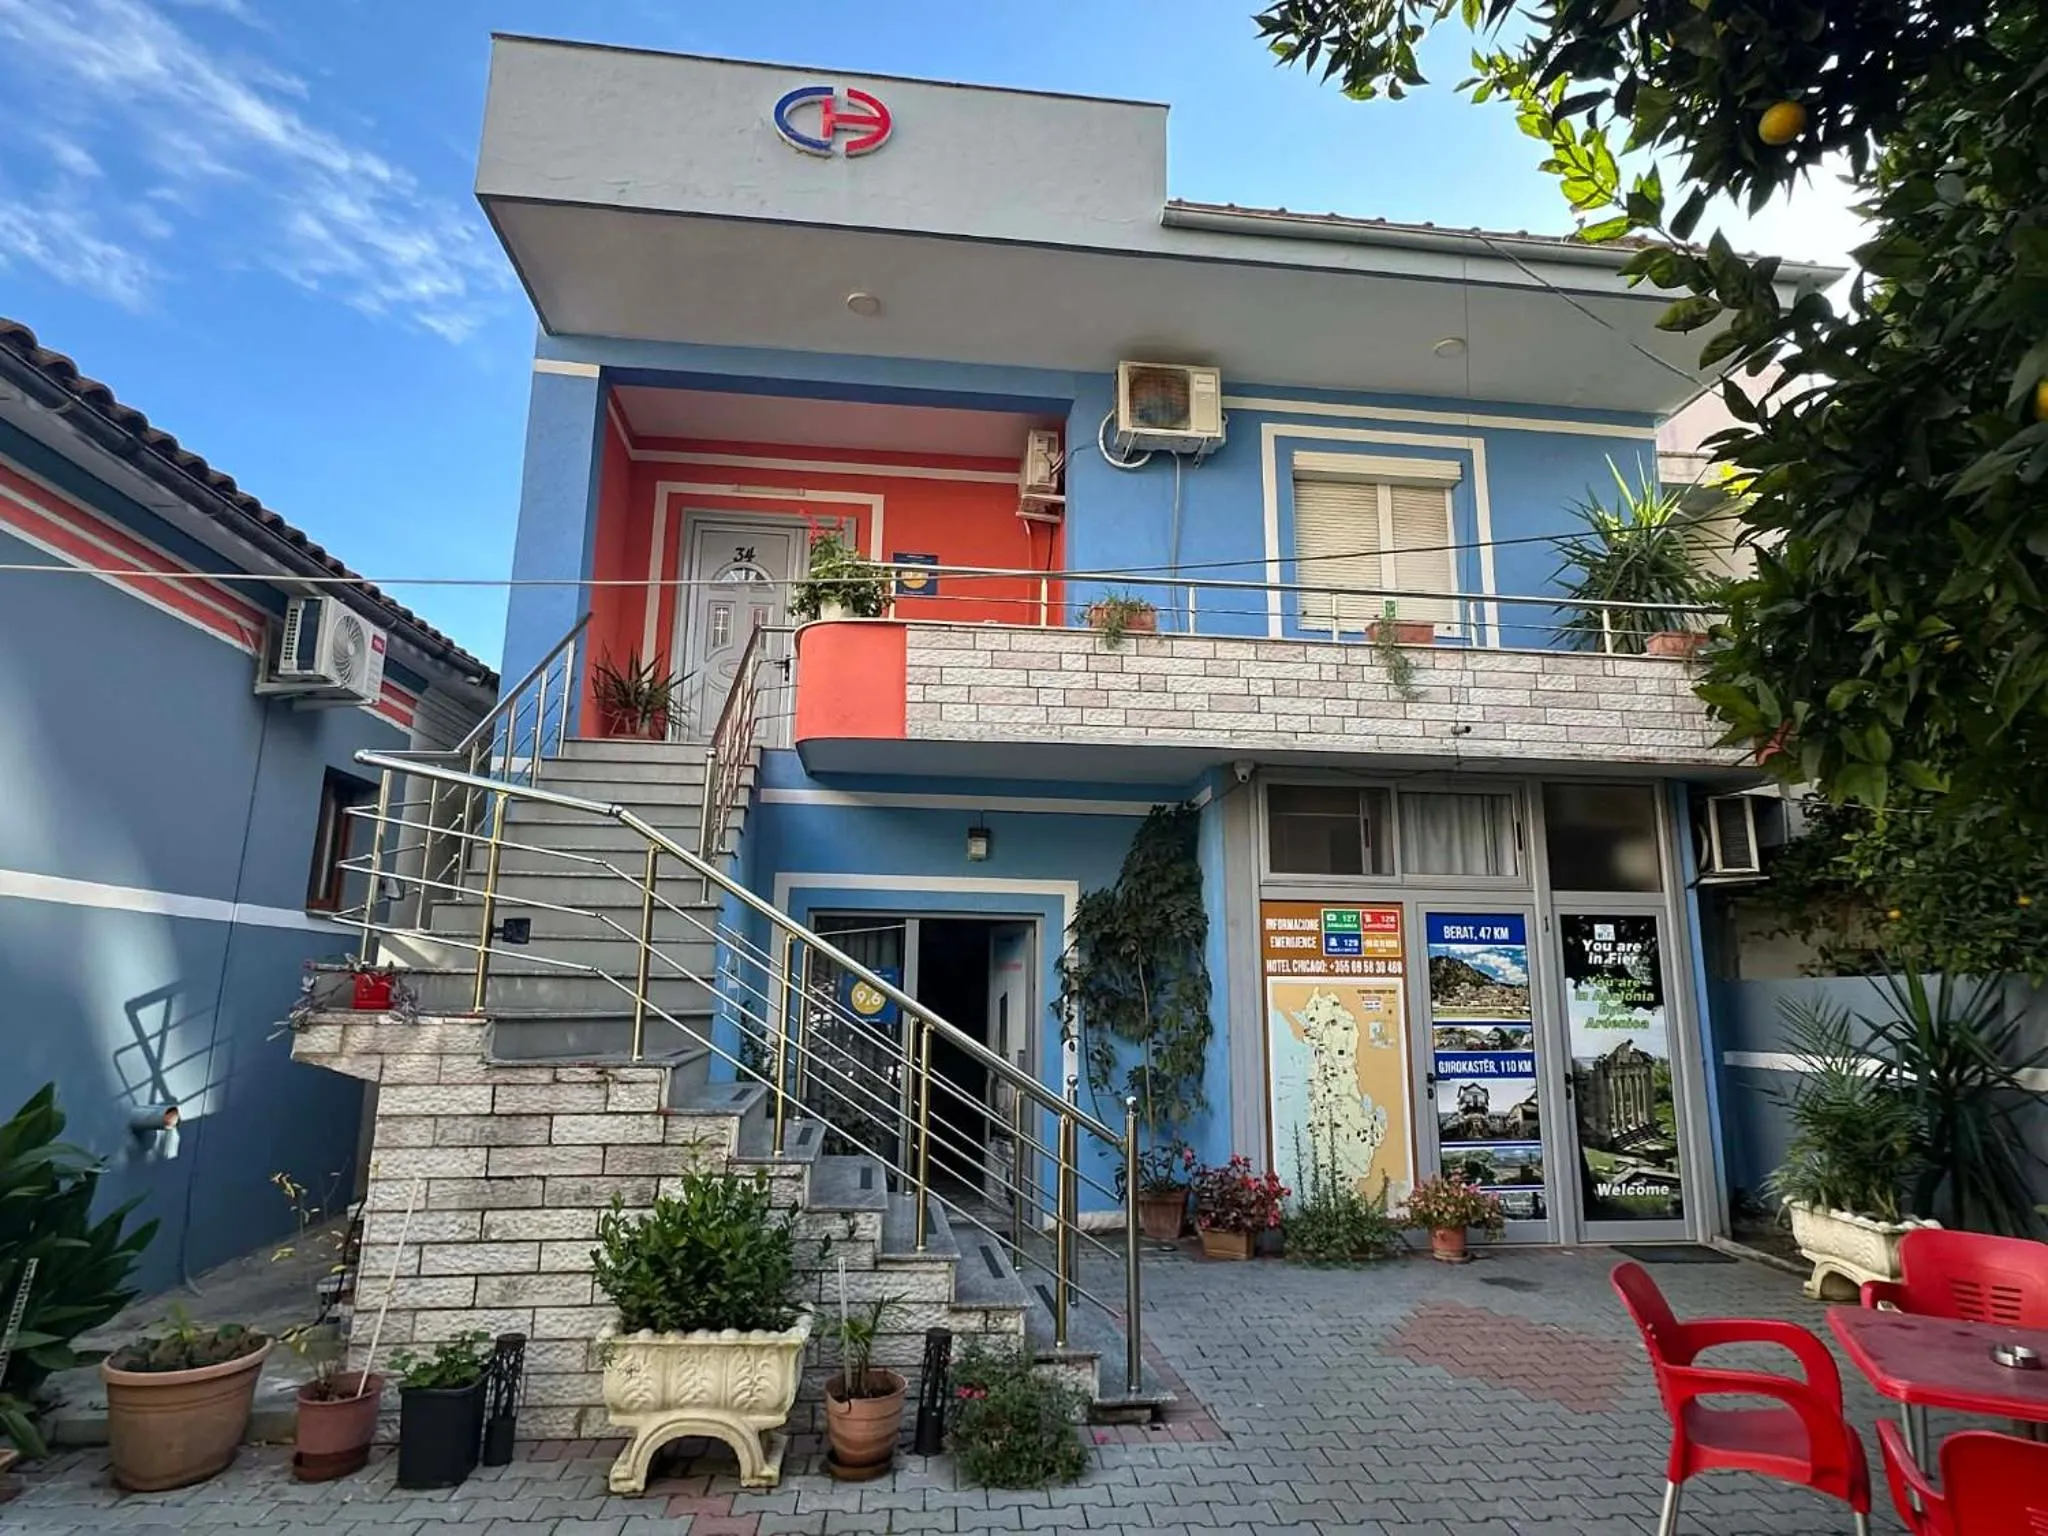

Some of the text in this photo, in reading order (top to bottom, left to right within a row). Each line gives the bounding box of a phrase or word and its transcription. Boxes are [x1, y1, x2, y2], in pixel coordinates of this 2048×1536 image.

[733, 546, 756, 562] 34
[1443, 925, 1509, 940] BERAT, 47 KM
[1582, 939, 1642, 953] You are
[1606, 952, 1638, 965] Fier
[1266, 959, 1291, 973] HOTEL
[1587, 976, 1641, 987] You are
[1438, 1058, 1533, 1074] GJIROKASTËR, 110 KM
[1596, 1183, 1670, 1197] Welcome
